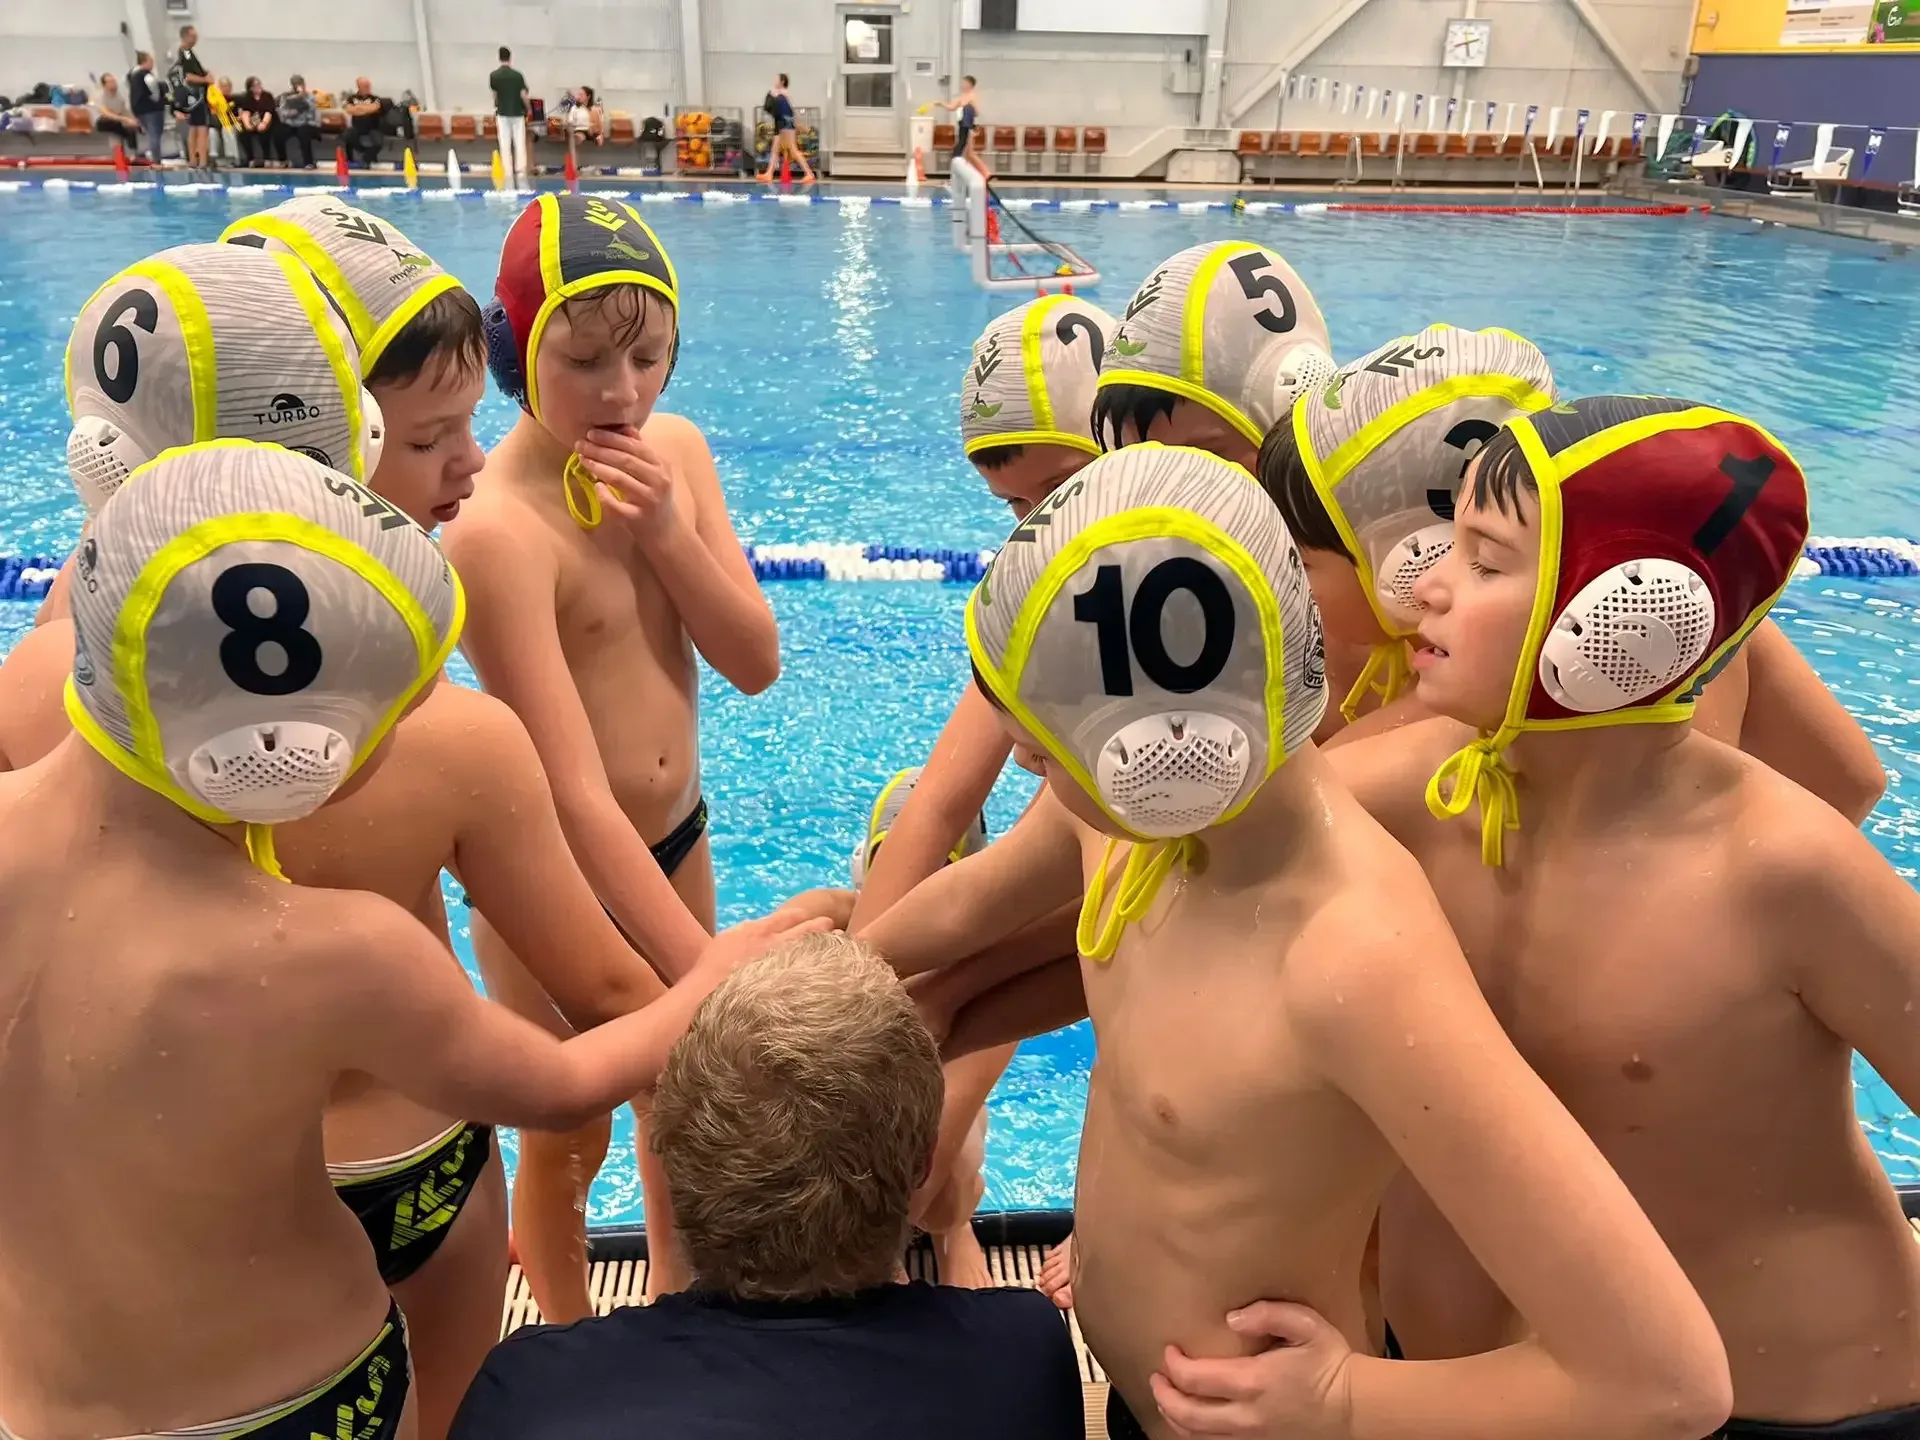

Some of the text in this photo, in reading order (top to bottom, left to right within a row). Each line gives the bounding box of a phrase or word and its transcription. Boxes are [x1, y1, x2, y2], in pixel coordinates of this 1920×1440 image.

[1723, 151, 1733, 164] 8
[1838, 162, 1848, 177] 7
[1229, 252, 1297, 333] 5
[94, 288, 159, 404] 6
[253, 406, 320, 425] TURBO
[1692, 453, 1777, 556] 1
[212, 562, 323, 696] 8
[1073, 556, 1236, 697] 10
